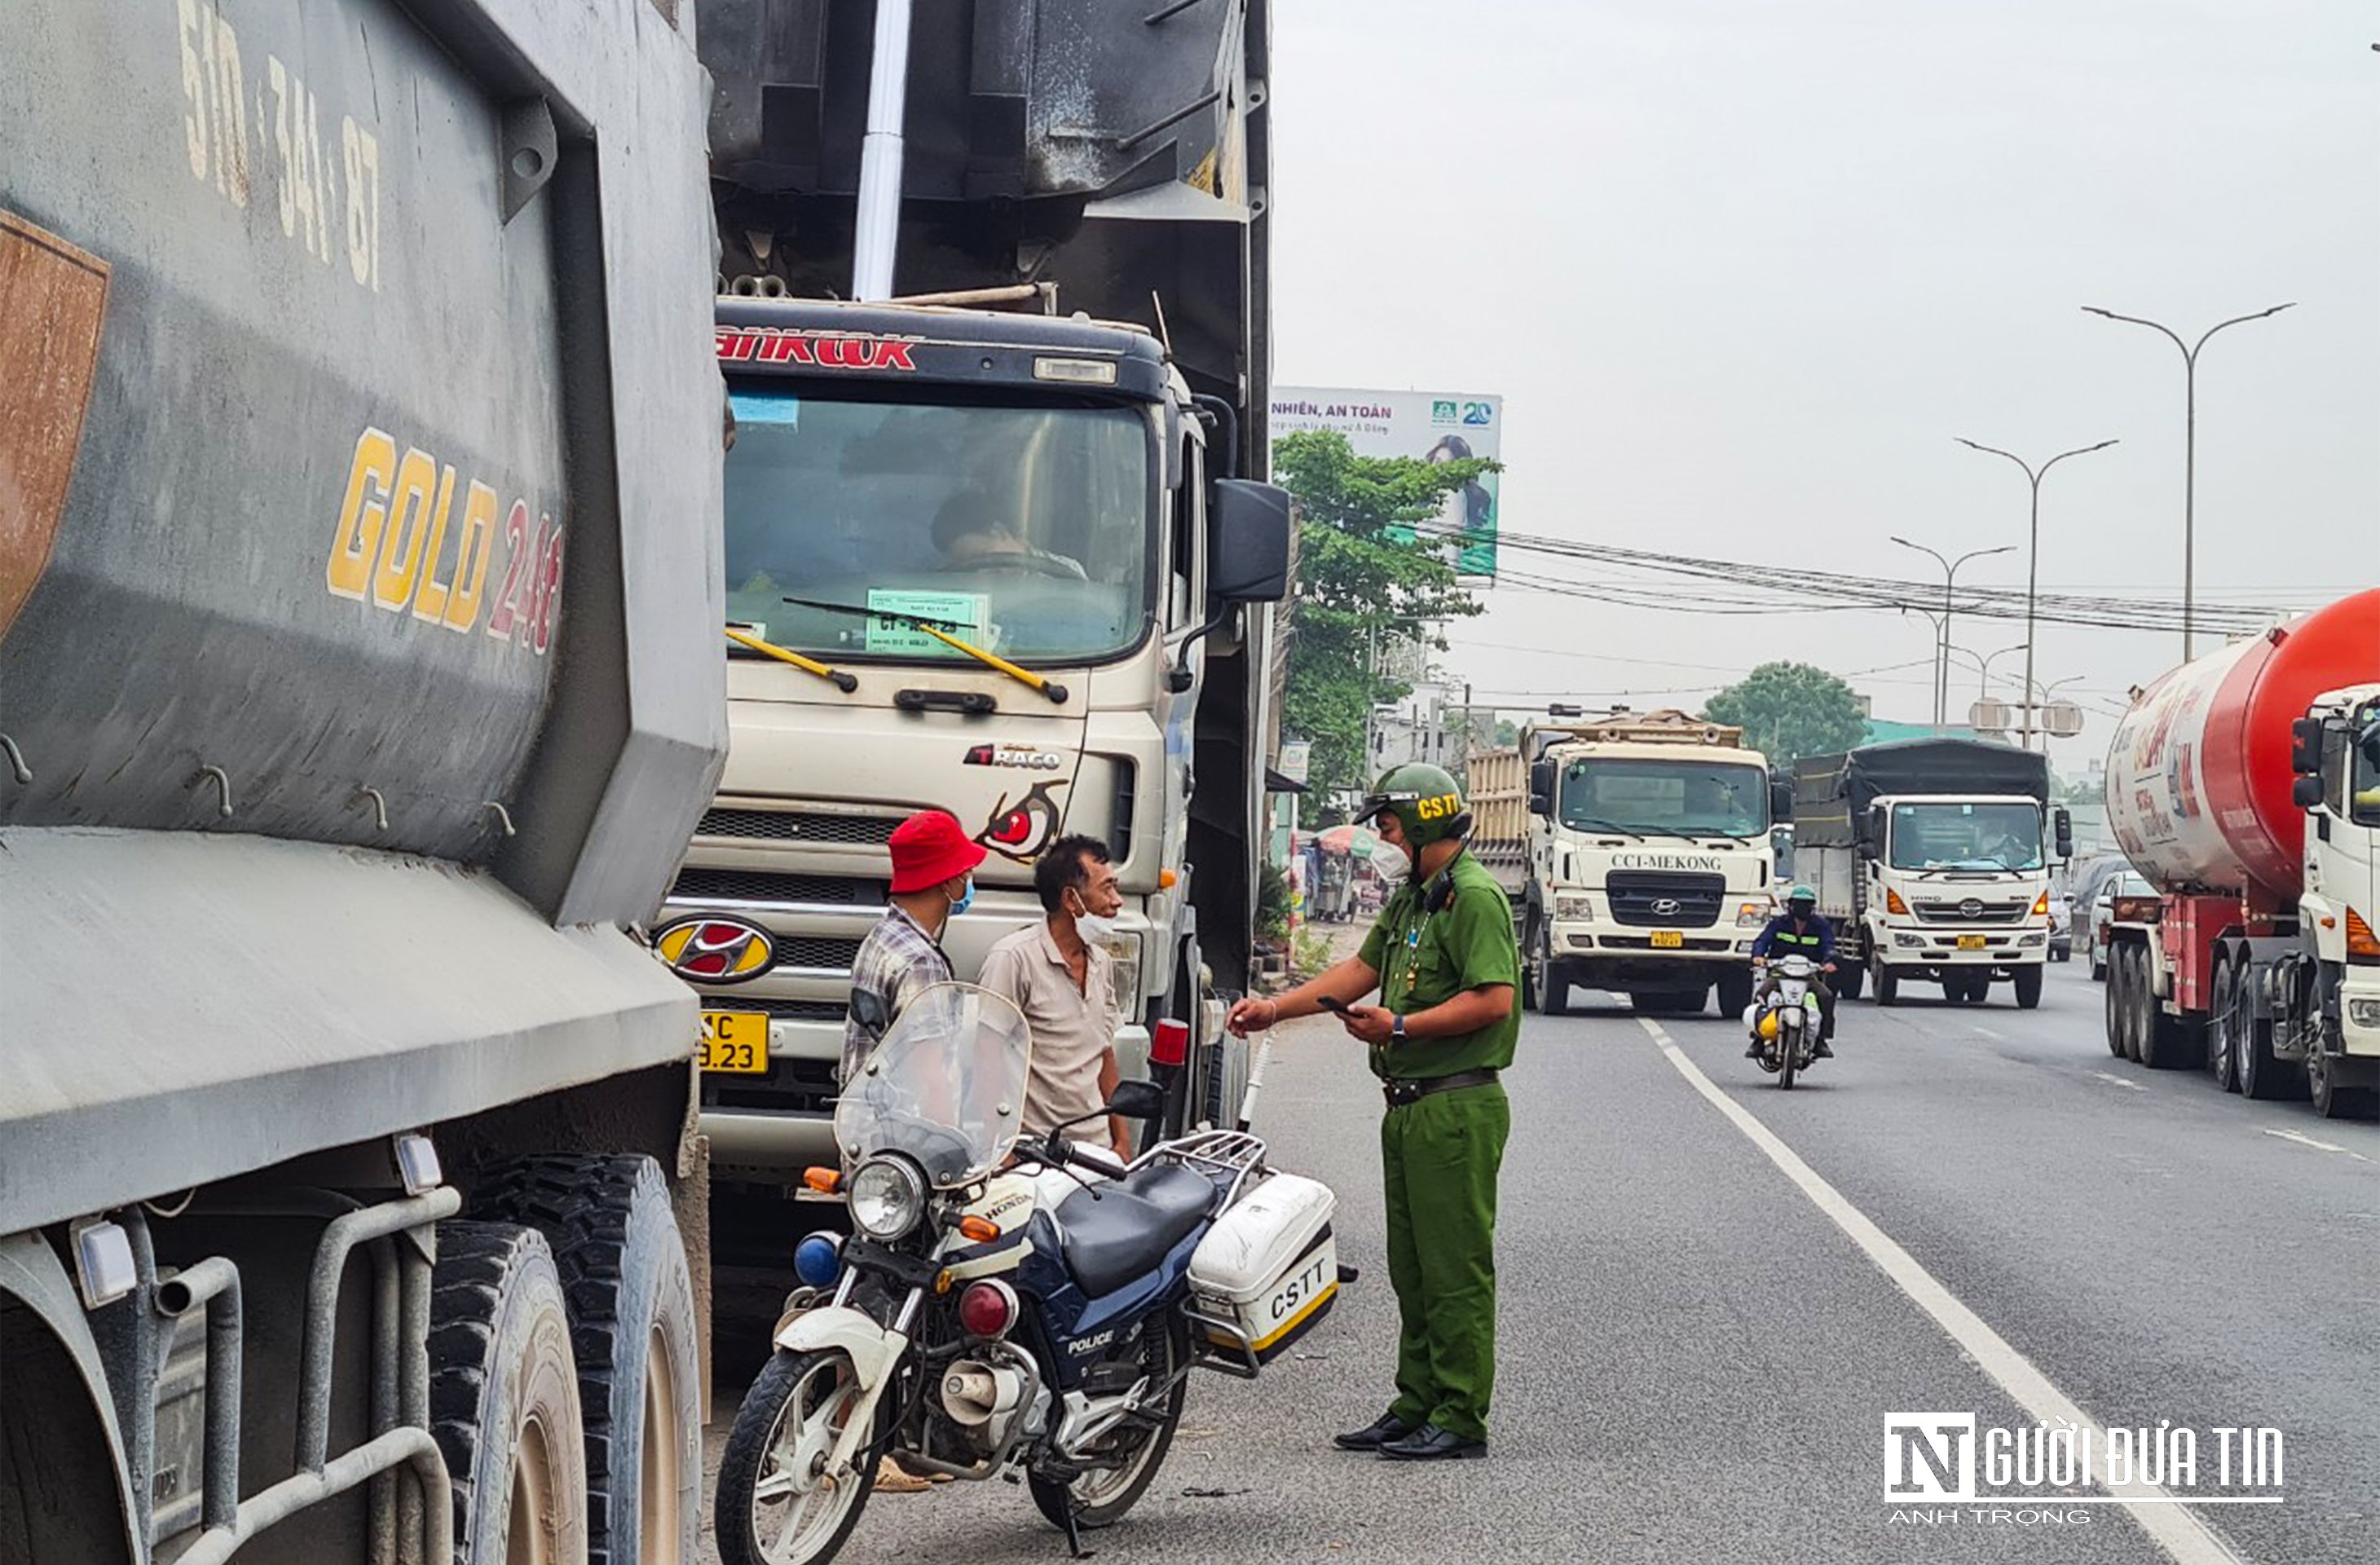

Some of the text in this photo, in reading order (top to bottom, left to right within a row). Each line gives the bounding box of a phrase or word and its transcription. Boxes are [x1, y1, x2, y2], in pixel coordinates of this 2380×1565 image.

[1326, 405, 1347, 417] AN
[1351, 403, 1392, 418] TOÀN
[1463, 402, 1492, 425] 20
[327, 426, 498, 634] GOLD
[1611, 853, 1721, 871] CCI-MEKONG
[985, 1194, 1033, 1220] HONDA
[1272, 1258, 1325, 1320] CSTT
[1068, 1329, 1115, 1355] POLICE
